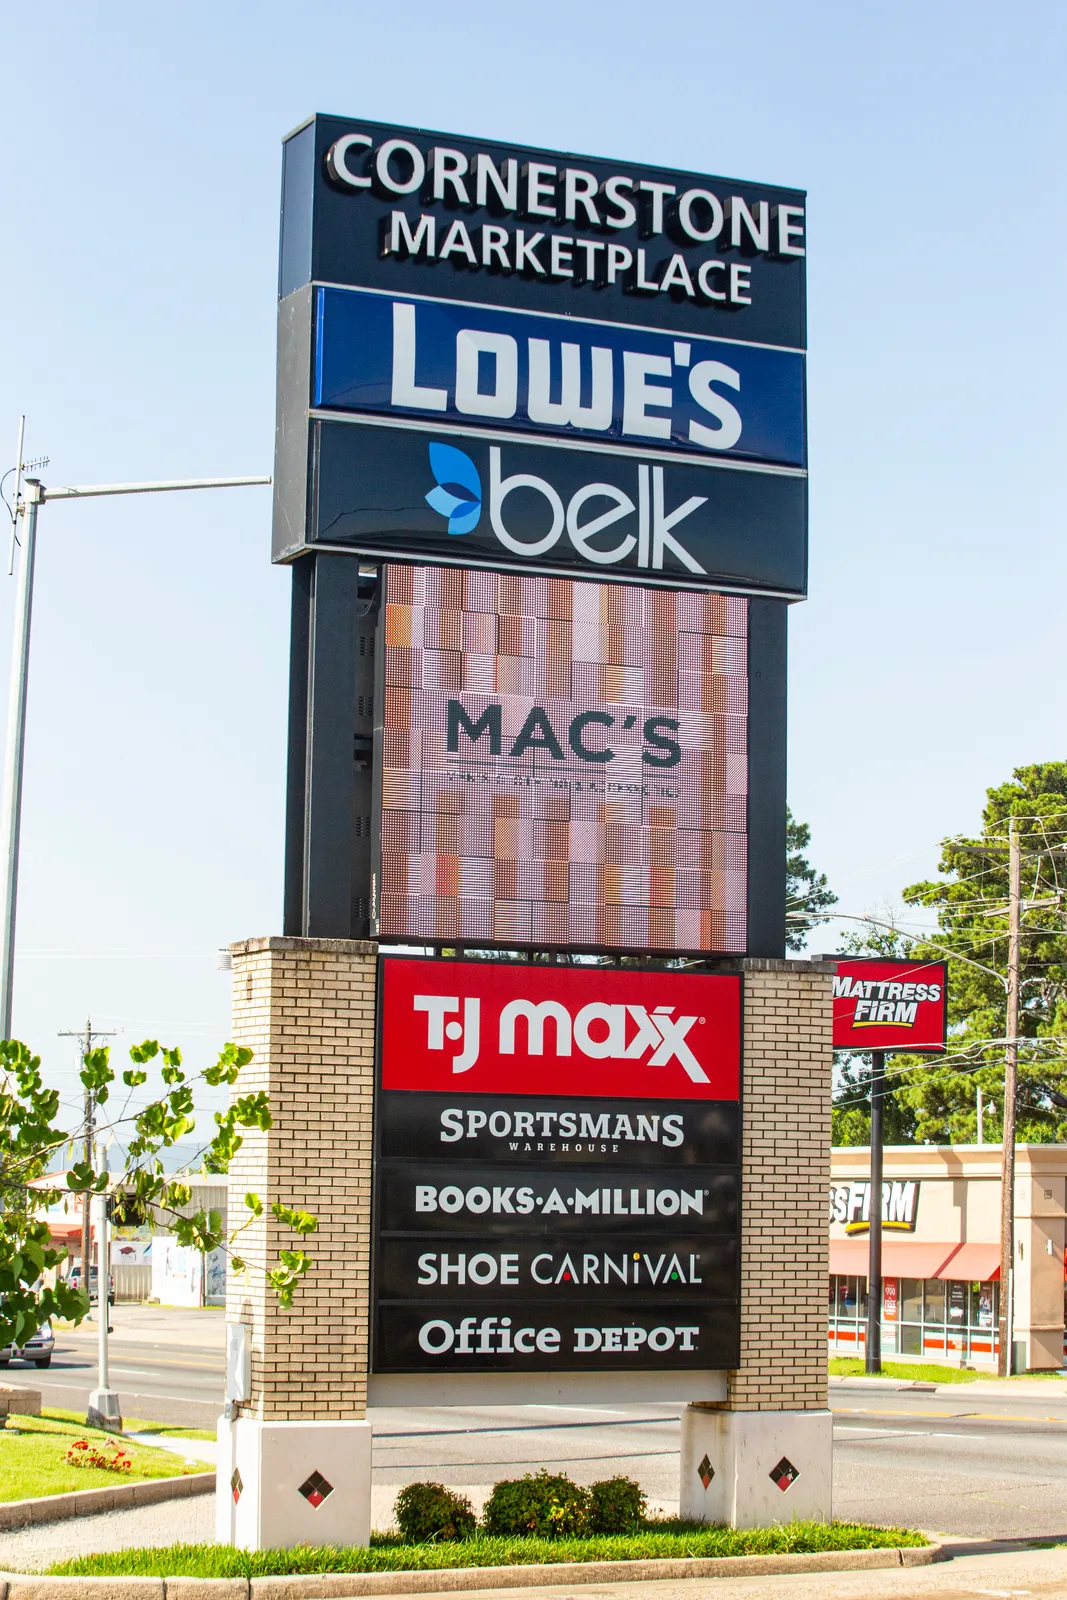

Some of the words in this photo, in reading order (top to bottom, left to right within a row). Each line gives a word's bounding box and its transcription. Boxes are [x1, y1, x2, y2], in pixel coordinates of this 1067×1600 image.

[327, 133, 805, 257] CORNERSTONE
[384, 210, 752, 305] MARKETPLACE
[391, 302, 743, 450] LOWE'S
[489, 446, 709, 575] belk
[446, 699, 681, 768] MAC'S
[832, 976, 941, 1002] MATTRESS
[854, 1000, 918, 1023] FIRM
[440, 1108, 685, 1148] SPORTSMANS
[509, 1142, 619, 1153] WAREHOUSE
[417, 1253, 519, 1285] SHOE
[418, 1317, 561, 1355] Office
[573, 1326, 700, 1352] DEPOT
